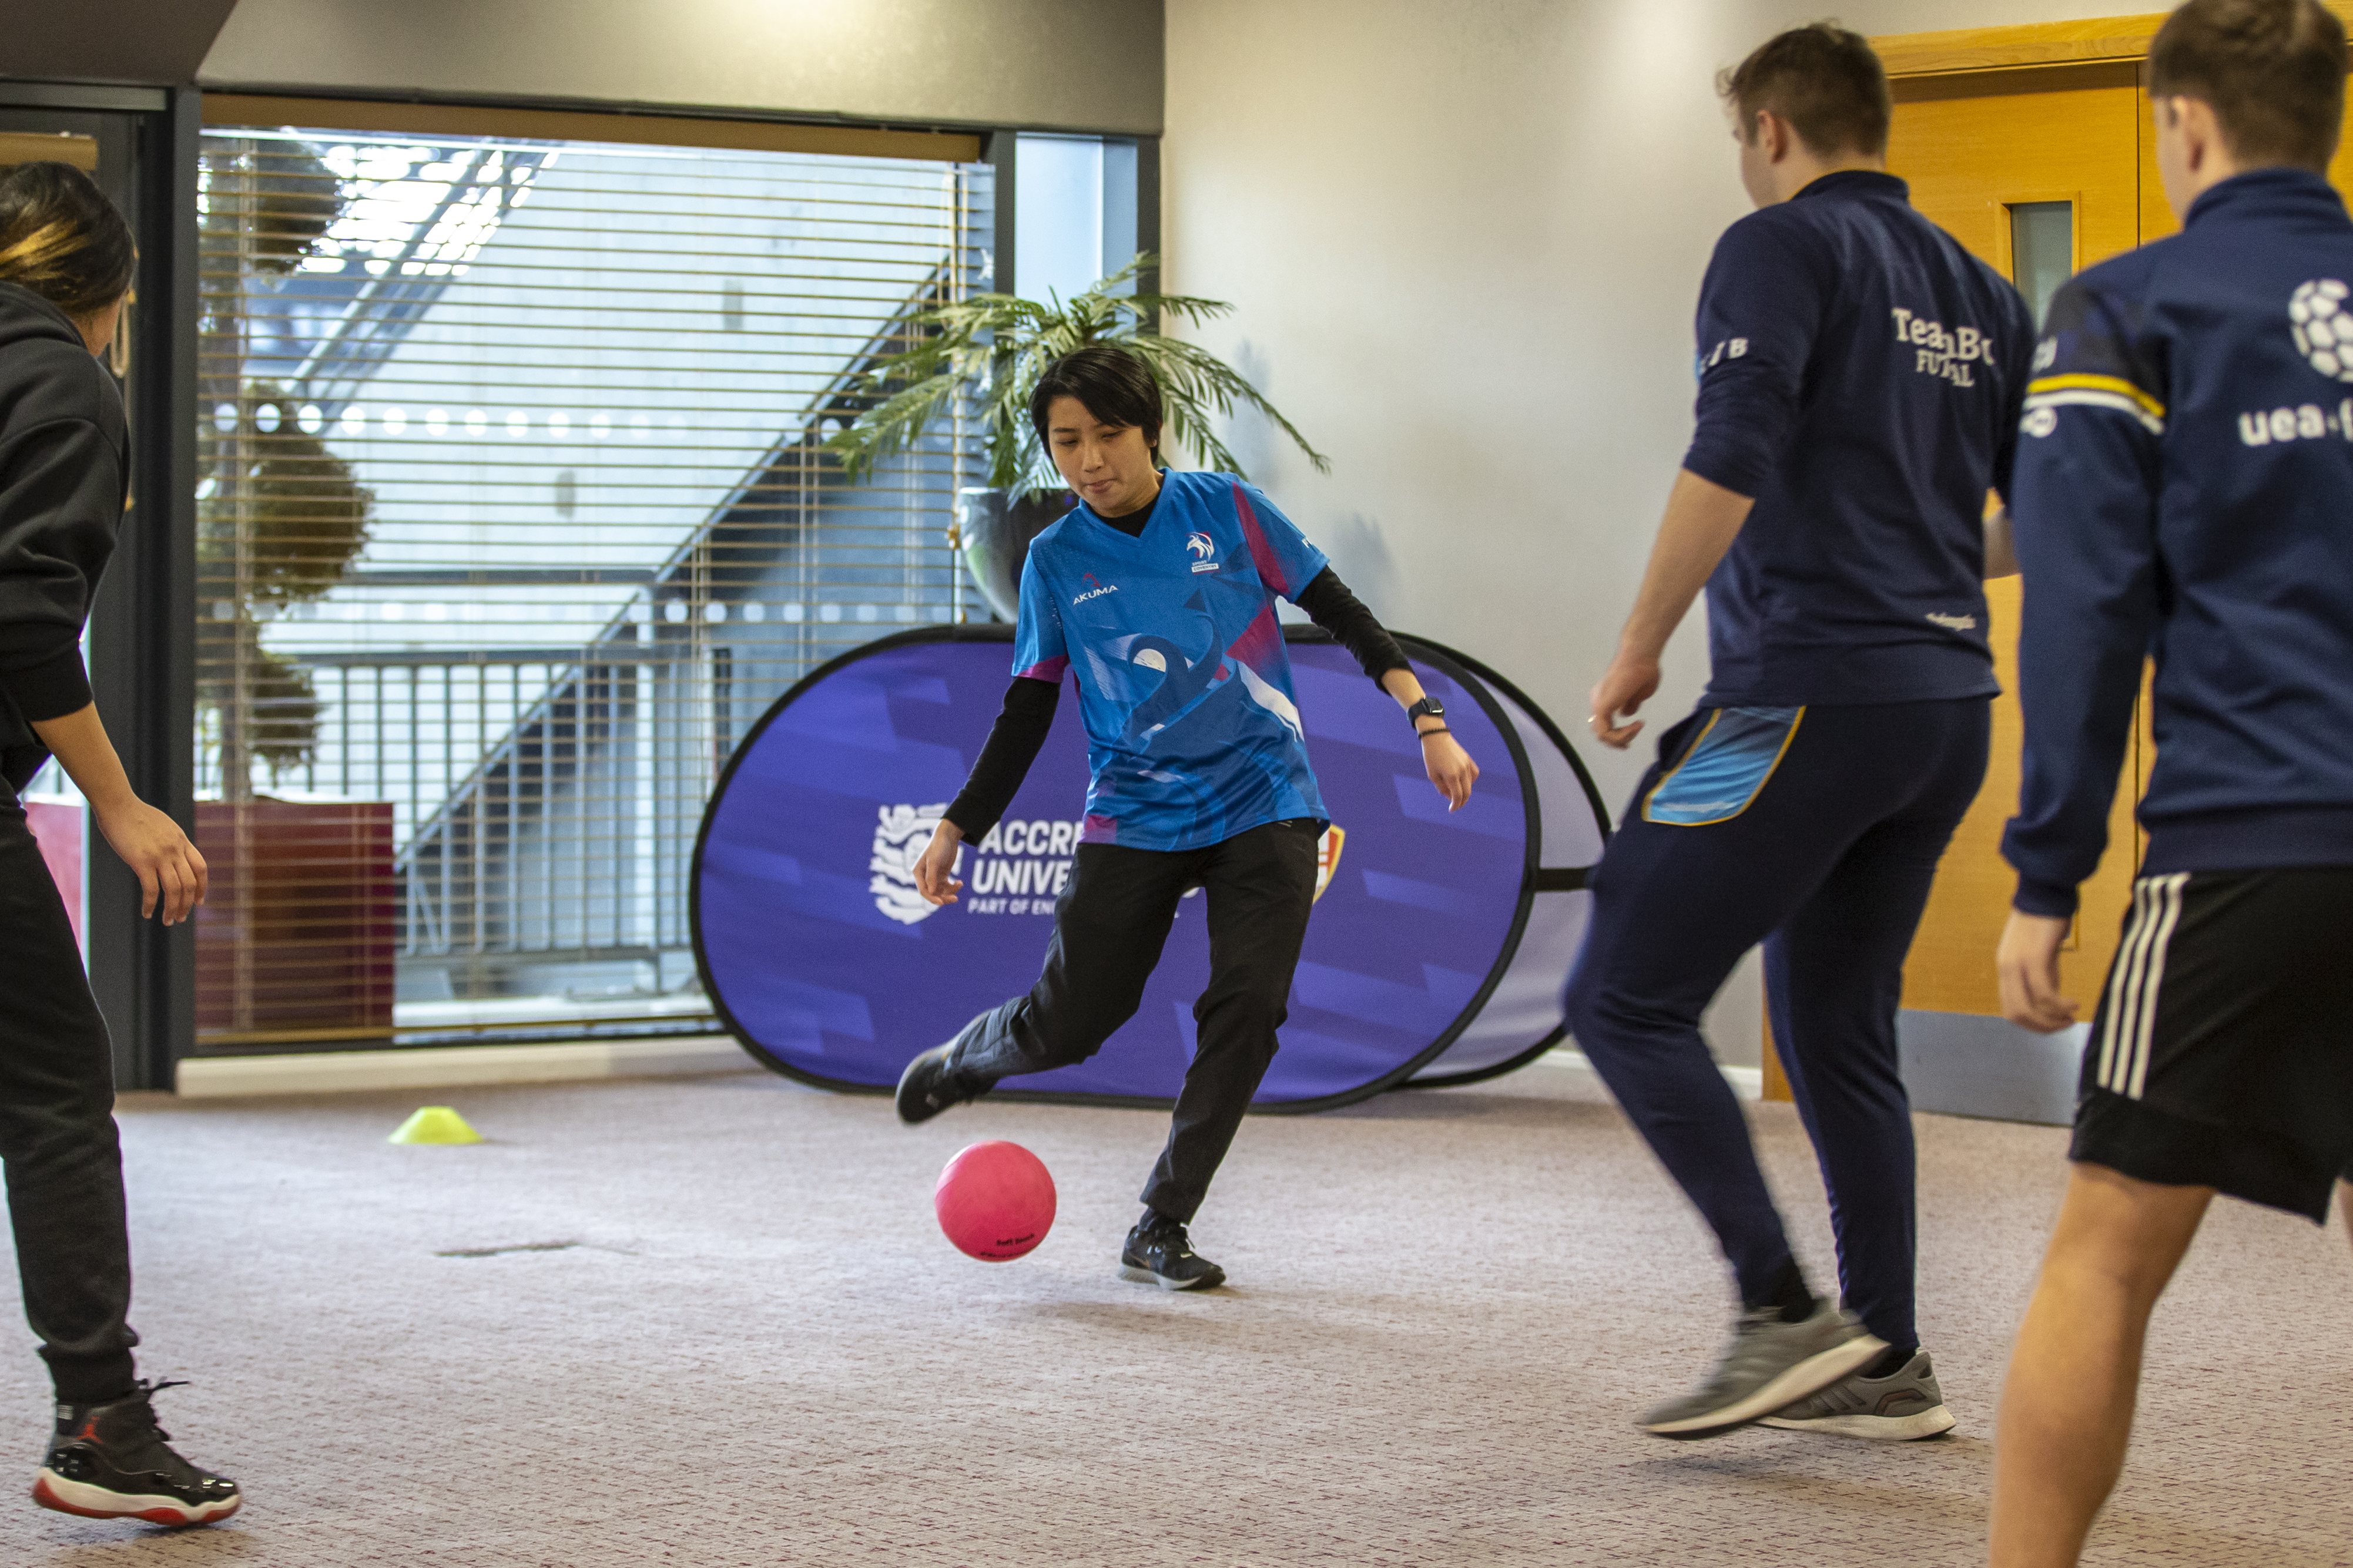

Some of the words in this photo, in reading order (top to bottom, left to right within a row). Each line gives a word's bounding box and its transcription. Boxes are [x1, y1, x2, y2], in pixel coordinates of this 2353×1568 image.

[1073, 585, 1119, 606] AKUMA
[967, 897, 1008, 915] PART
[1009, 898, 1028, 915] OF
